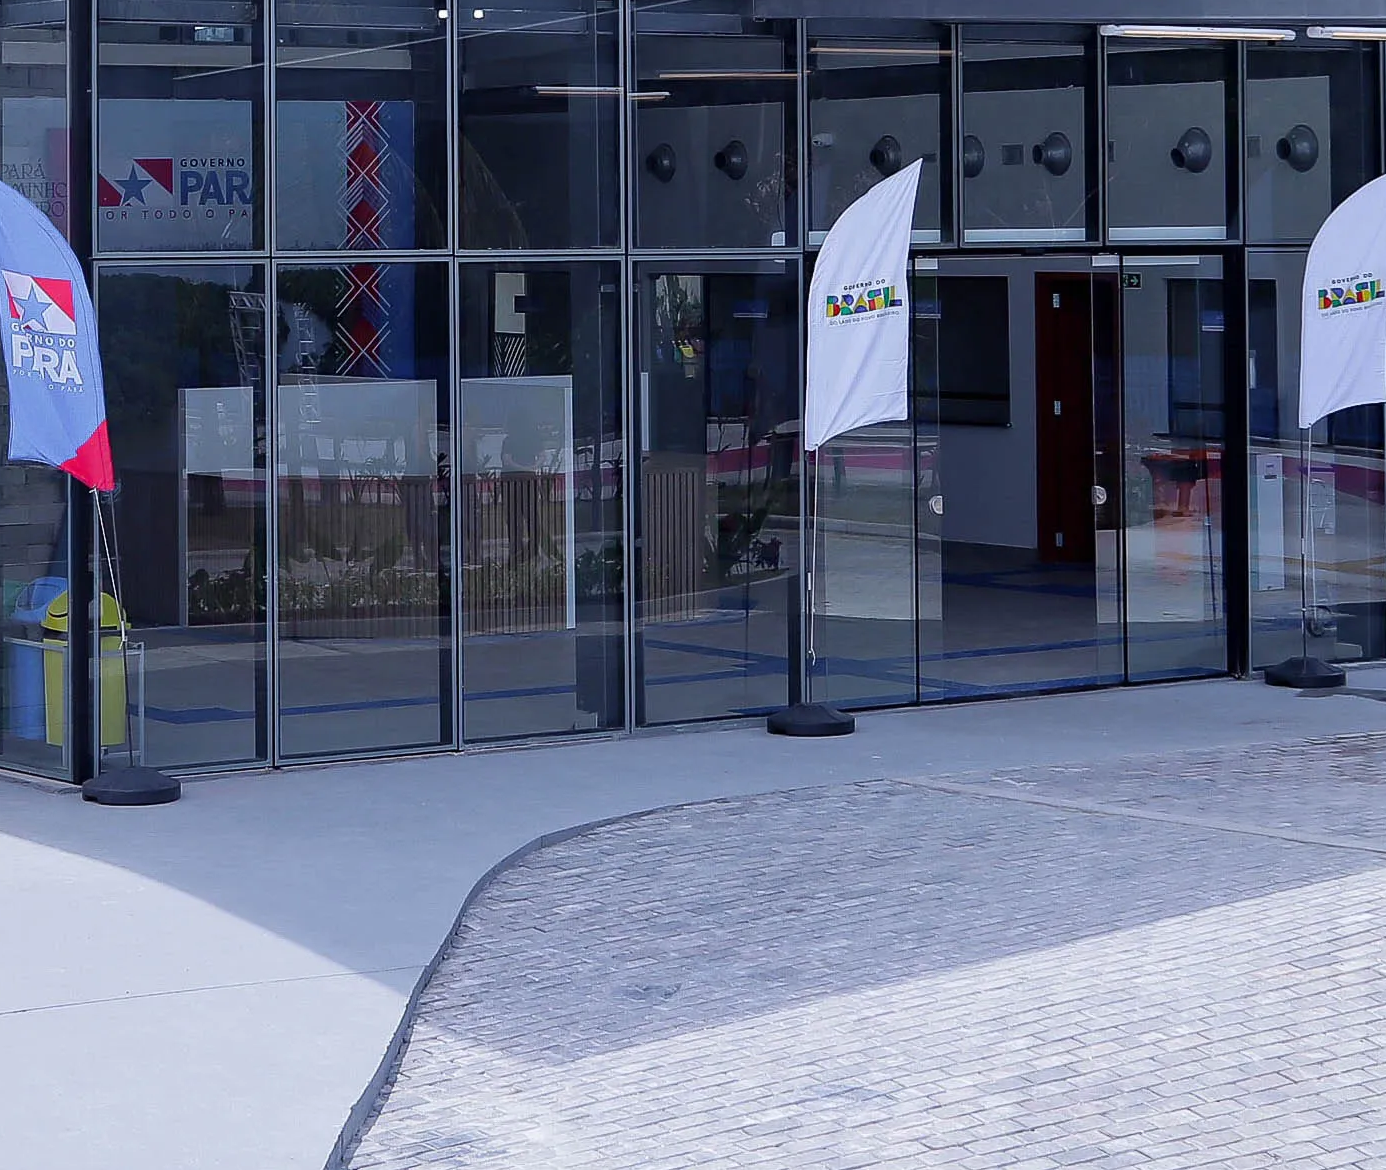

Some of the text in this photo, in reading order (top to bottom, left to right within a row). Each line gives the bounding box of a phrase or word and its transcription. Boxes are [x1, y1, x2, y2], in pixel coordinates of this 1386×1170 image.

[180, 158, 246, 168] GOVERNO
[180, 170, 252, 205] PAR
[106, 209, 249, 220] OR TODO O PA
[826, 286, 903, 318] BRASIL
[1318, 279, 1386, 310] BRASIL
[59, 337, 75, 348] DO
